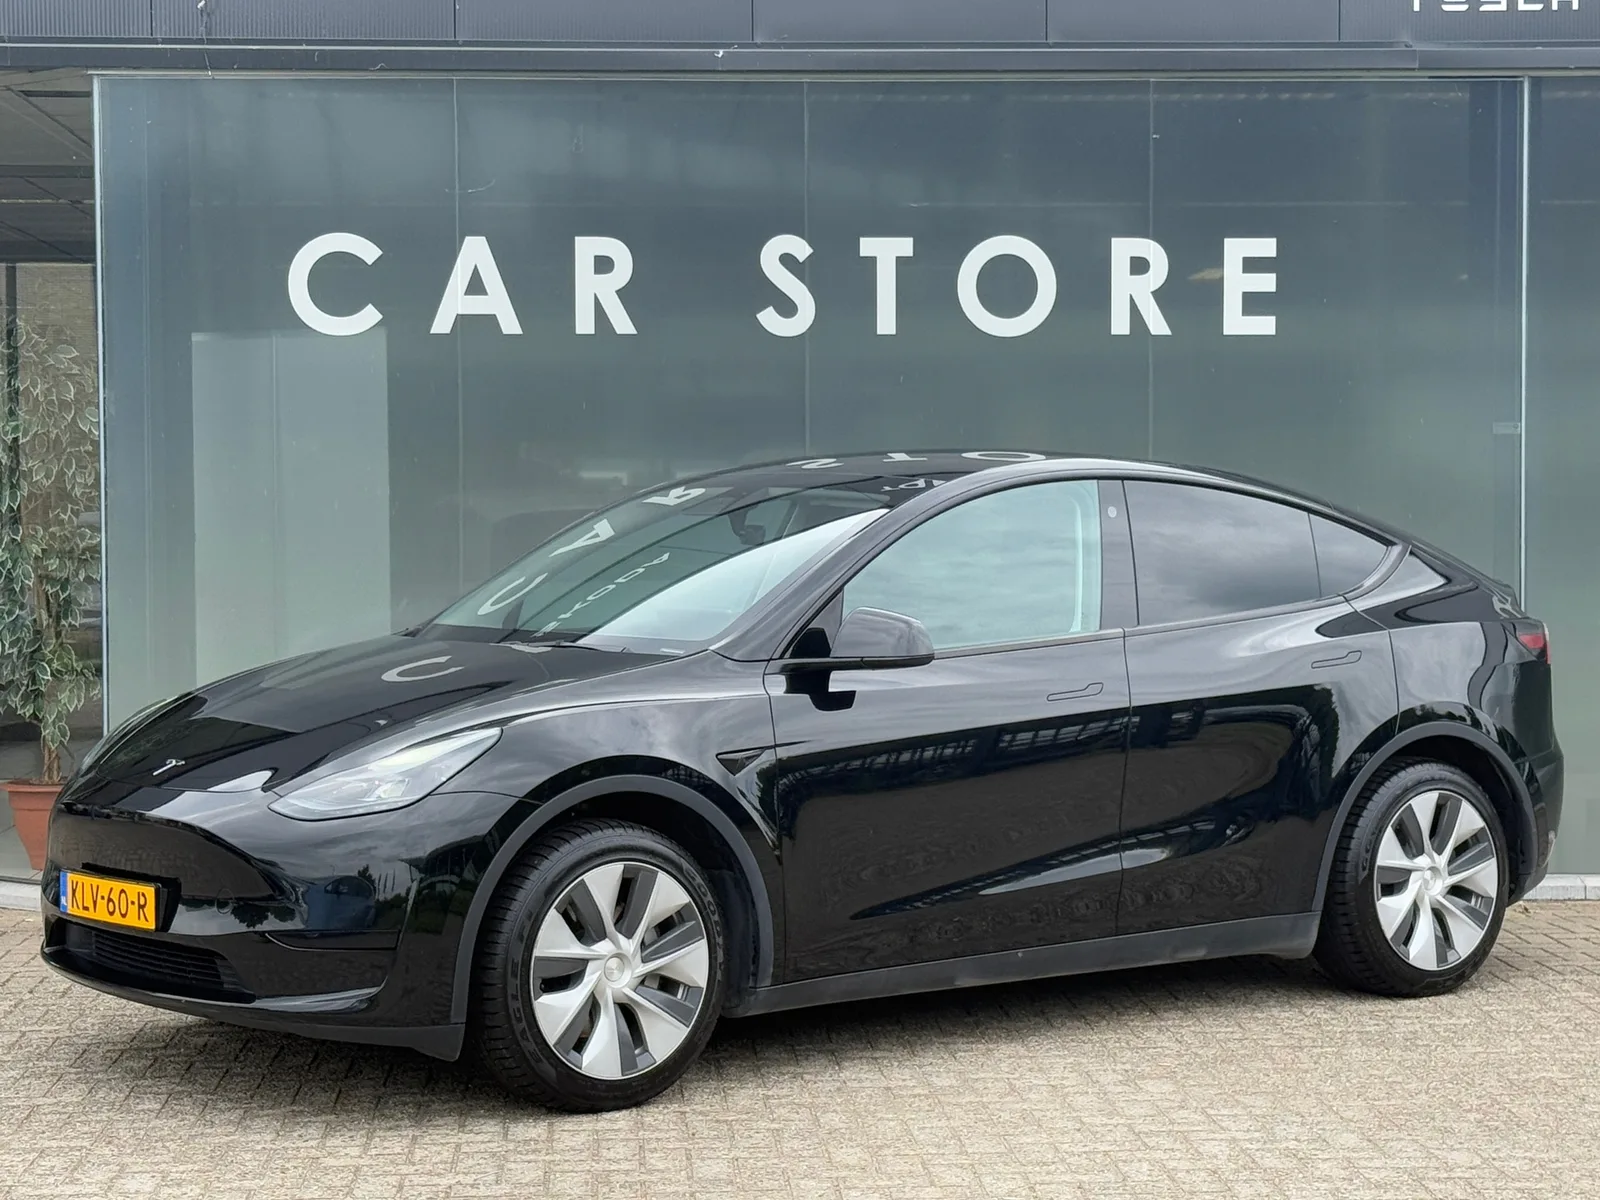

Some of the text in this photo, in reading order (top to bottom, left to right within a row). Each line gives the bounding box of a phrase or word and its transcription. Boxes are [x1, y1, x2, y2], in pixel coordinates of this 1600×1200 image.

[287, 232, 1278, 338] CAR STORE
[71, 879, 150, 923] KLV-60-R
